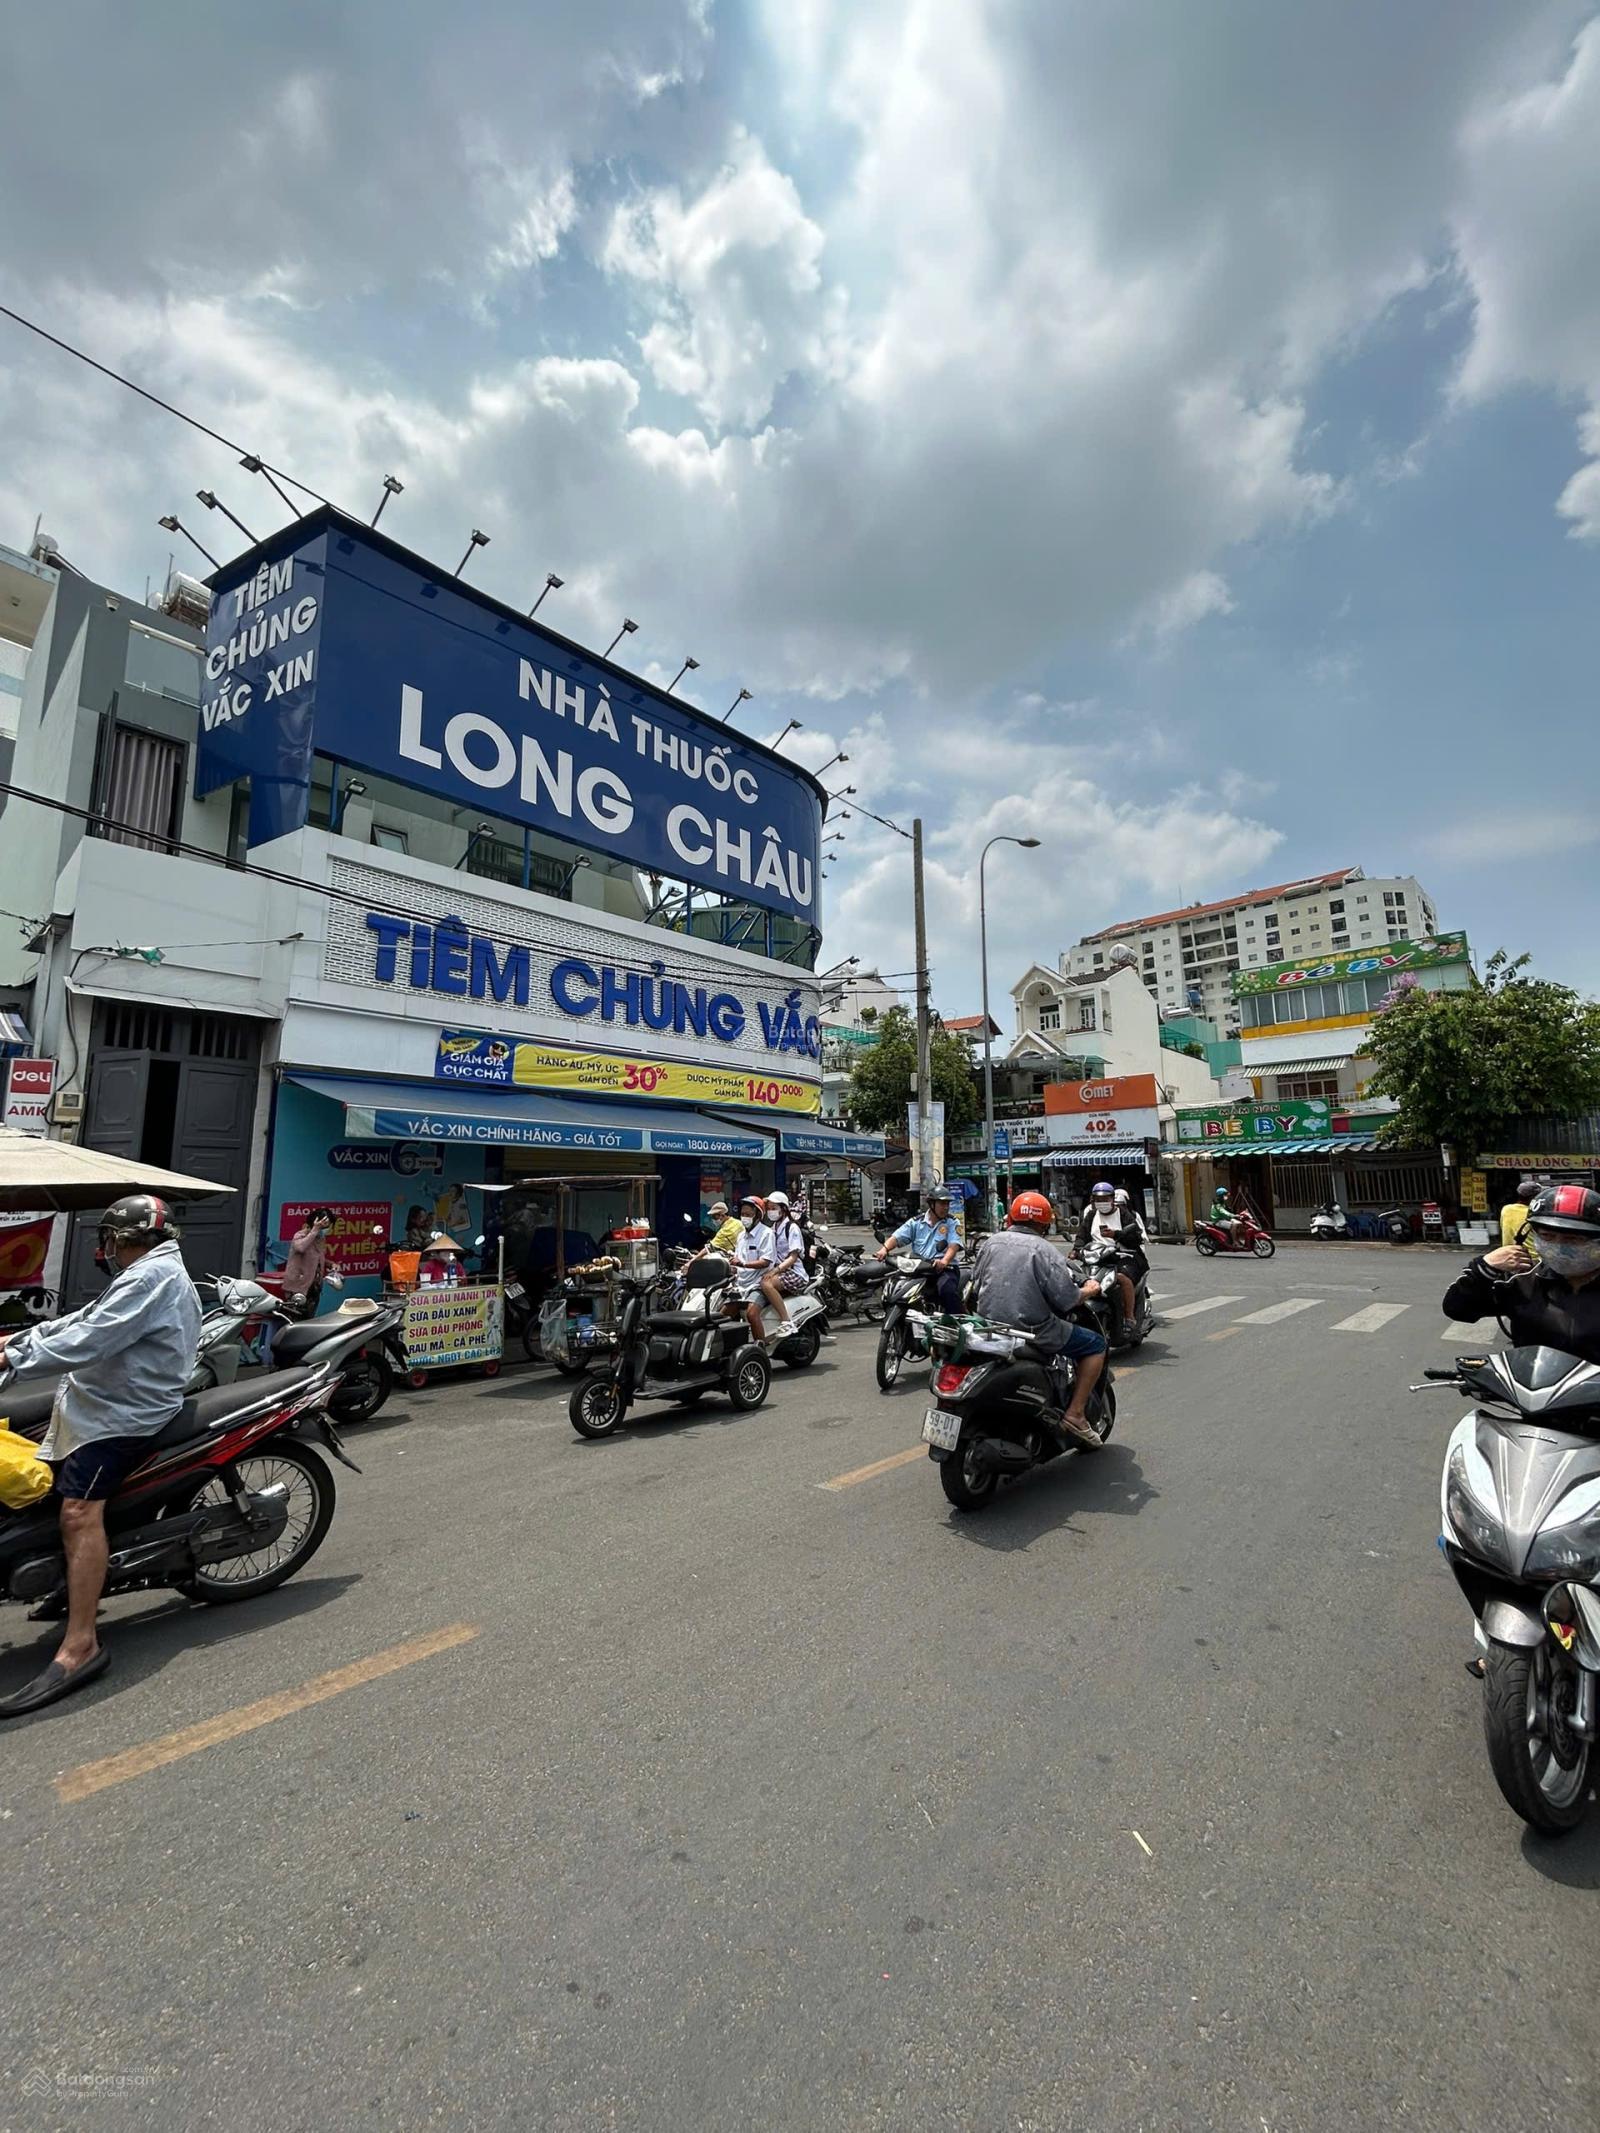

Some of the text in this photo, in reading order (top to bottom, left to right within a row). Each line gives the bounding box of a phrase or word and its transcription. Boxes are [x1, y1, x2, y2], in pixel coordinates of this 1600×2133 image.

[234, 555, 296, 619] TIÊM
[205, 596, 318, 681] CHỦNG
[202, 649, 314, 732] VẮC XIN
[518, 658, 759, 804] NHÀ THUỐC
[399, 683, 812, 907] LONG CHÂU
[366, 912, 531, 1006] TIÊM
[550, 958, 746, 1042] CHỦNG
[12, 1070, 51, 1083] deli
[623, 1064, 668, 1091] 30%
[407, 1116, 444, 1136] VẮC
[447, 1123, 473, 1138] XIN
[475, 1123, 520, 1141] CHÍNH
[573, 1130, 595, 1145] GIÁ
[598, 1131, 622, 1147] TỐT
[1085, 1119, 1117, 1133] 402
[1254, 1115, 1299, 1134] BY
[334, 1148, 389, 1164] VẮC XIN
[687, 1139, 709, 1150] 1800
[710, 1140, 732, 1152] 6928
[453, 1306, 478, 1317] XANH
[409, 1342, 427, 1354] RAU
